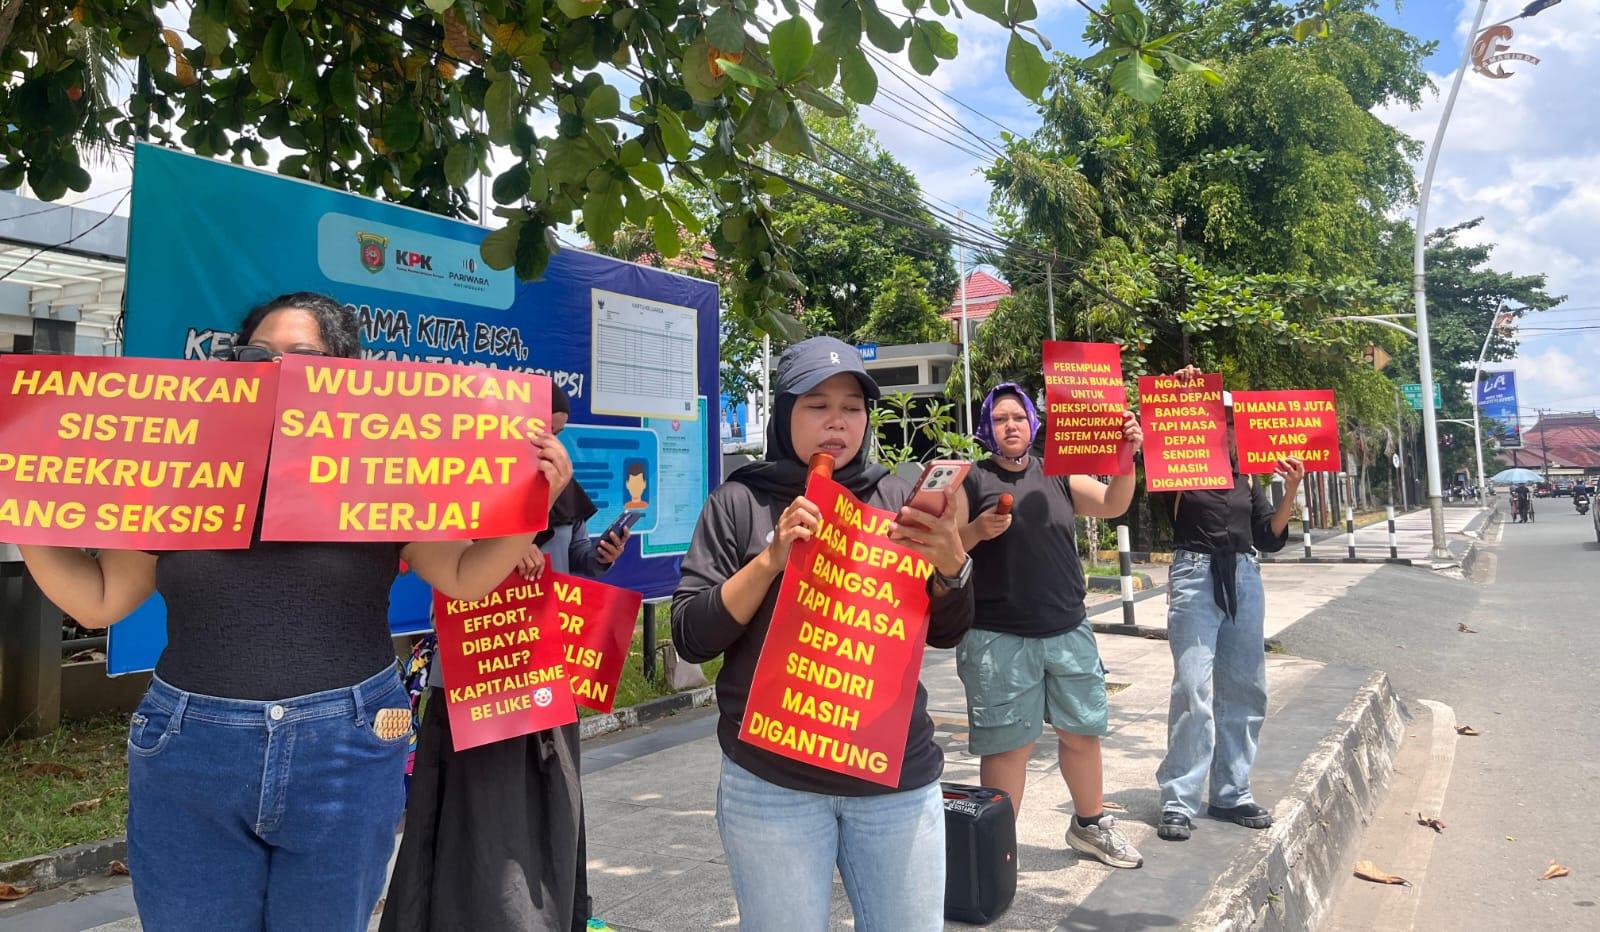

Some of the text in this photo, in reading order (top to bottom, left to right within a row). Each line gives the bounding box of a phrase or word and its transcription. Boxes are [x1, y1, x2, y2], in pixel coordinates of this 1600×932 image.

[396, 249, 432, 271] KPK
[449, 272, 489, 286] PARIWARA
[416, 314, 469, 354] KITA
[474, 322, 529, 361] BISA,
[1046, 375, 1123, 387] BEKERJA BUKAN
[1053, 362, 1111, 373] PEREMPUAN
[11, 371, 260, 404] HANCURKAN
[305, 366, 531, 403] WUJUDKAN
[1071, 389, 1104, 399] UNTUK
[1141, 391, 1221, 404] MASA DEPAN
[1154, 406, 1209, 418] BANGSA,
[1233, 400, 1335, 413] DI MANA 19 JUTA
[57, 413, 200, 445] SISTEM
[281, 409, 545, 441] SATGAS PPKS
[1054, 430, 1123, 441] SISTEM YANG
[1056, 417, 1123, 427] HANCURKAN
[1151, 420, 1216, 432] TAPI MASA
[1249, 417, 1322, 430] PEKERJAAN
[1058, 444, 1117, 455] MENINDAS!
[1164, 434, 1206, 446] DEPAN
[1268, 433, 1308, 446] YANG
[1162, 449, 1210, 460] SENDIRI
[0, 453, 245, 489] PEREKRUTAN
[309, 455, 518, 485] DI TEMPAT
[1152, 476, 1227, 488] DIGANTUNG
[1167, 463, 1208, 474] MASIH
[0, 498, 86, 530] ANG
[95, 503, 224, 533] SEKSIS
[339, 500, 481, 532] KERJA!
[834, 493, 891, 536] NGAJA
[815, 518, 934, 580] ASA DEPAN
[553, 581, 582, 606] NA
[812, 553, 901, 608] BANGSA,
[446, 583, 544, 615] KERJA FULL
[796, 580, 906, 640] TAPI MASA
[463, 607, 533, 633] EFFORT,
[558, 612, 584, 635] OR
[462, 626, 541, 656] DIBAYAR
[798, 622, 875, 666] DEPAN
[477, 650, 531, 675] HALF?
[563, 643, 603, 670] LISI
[449, 664, 565, 704] KAPITALISME
[569, 675, 609, 703] KAN
[786, 652, 875, 700] SENDIRI
[470, 694, 532, 721] BE LIKE
[781, 687, 860, 731] MASIH
[748, 712, 889, 774] DIGANTUNG
